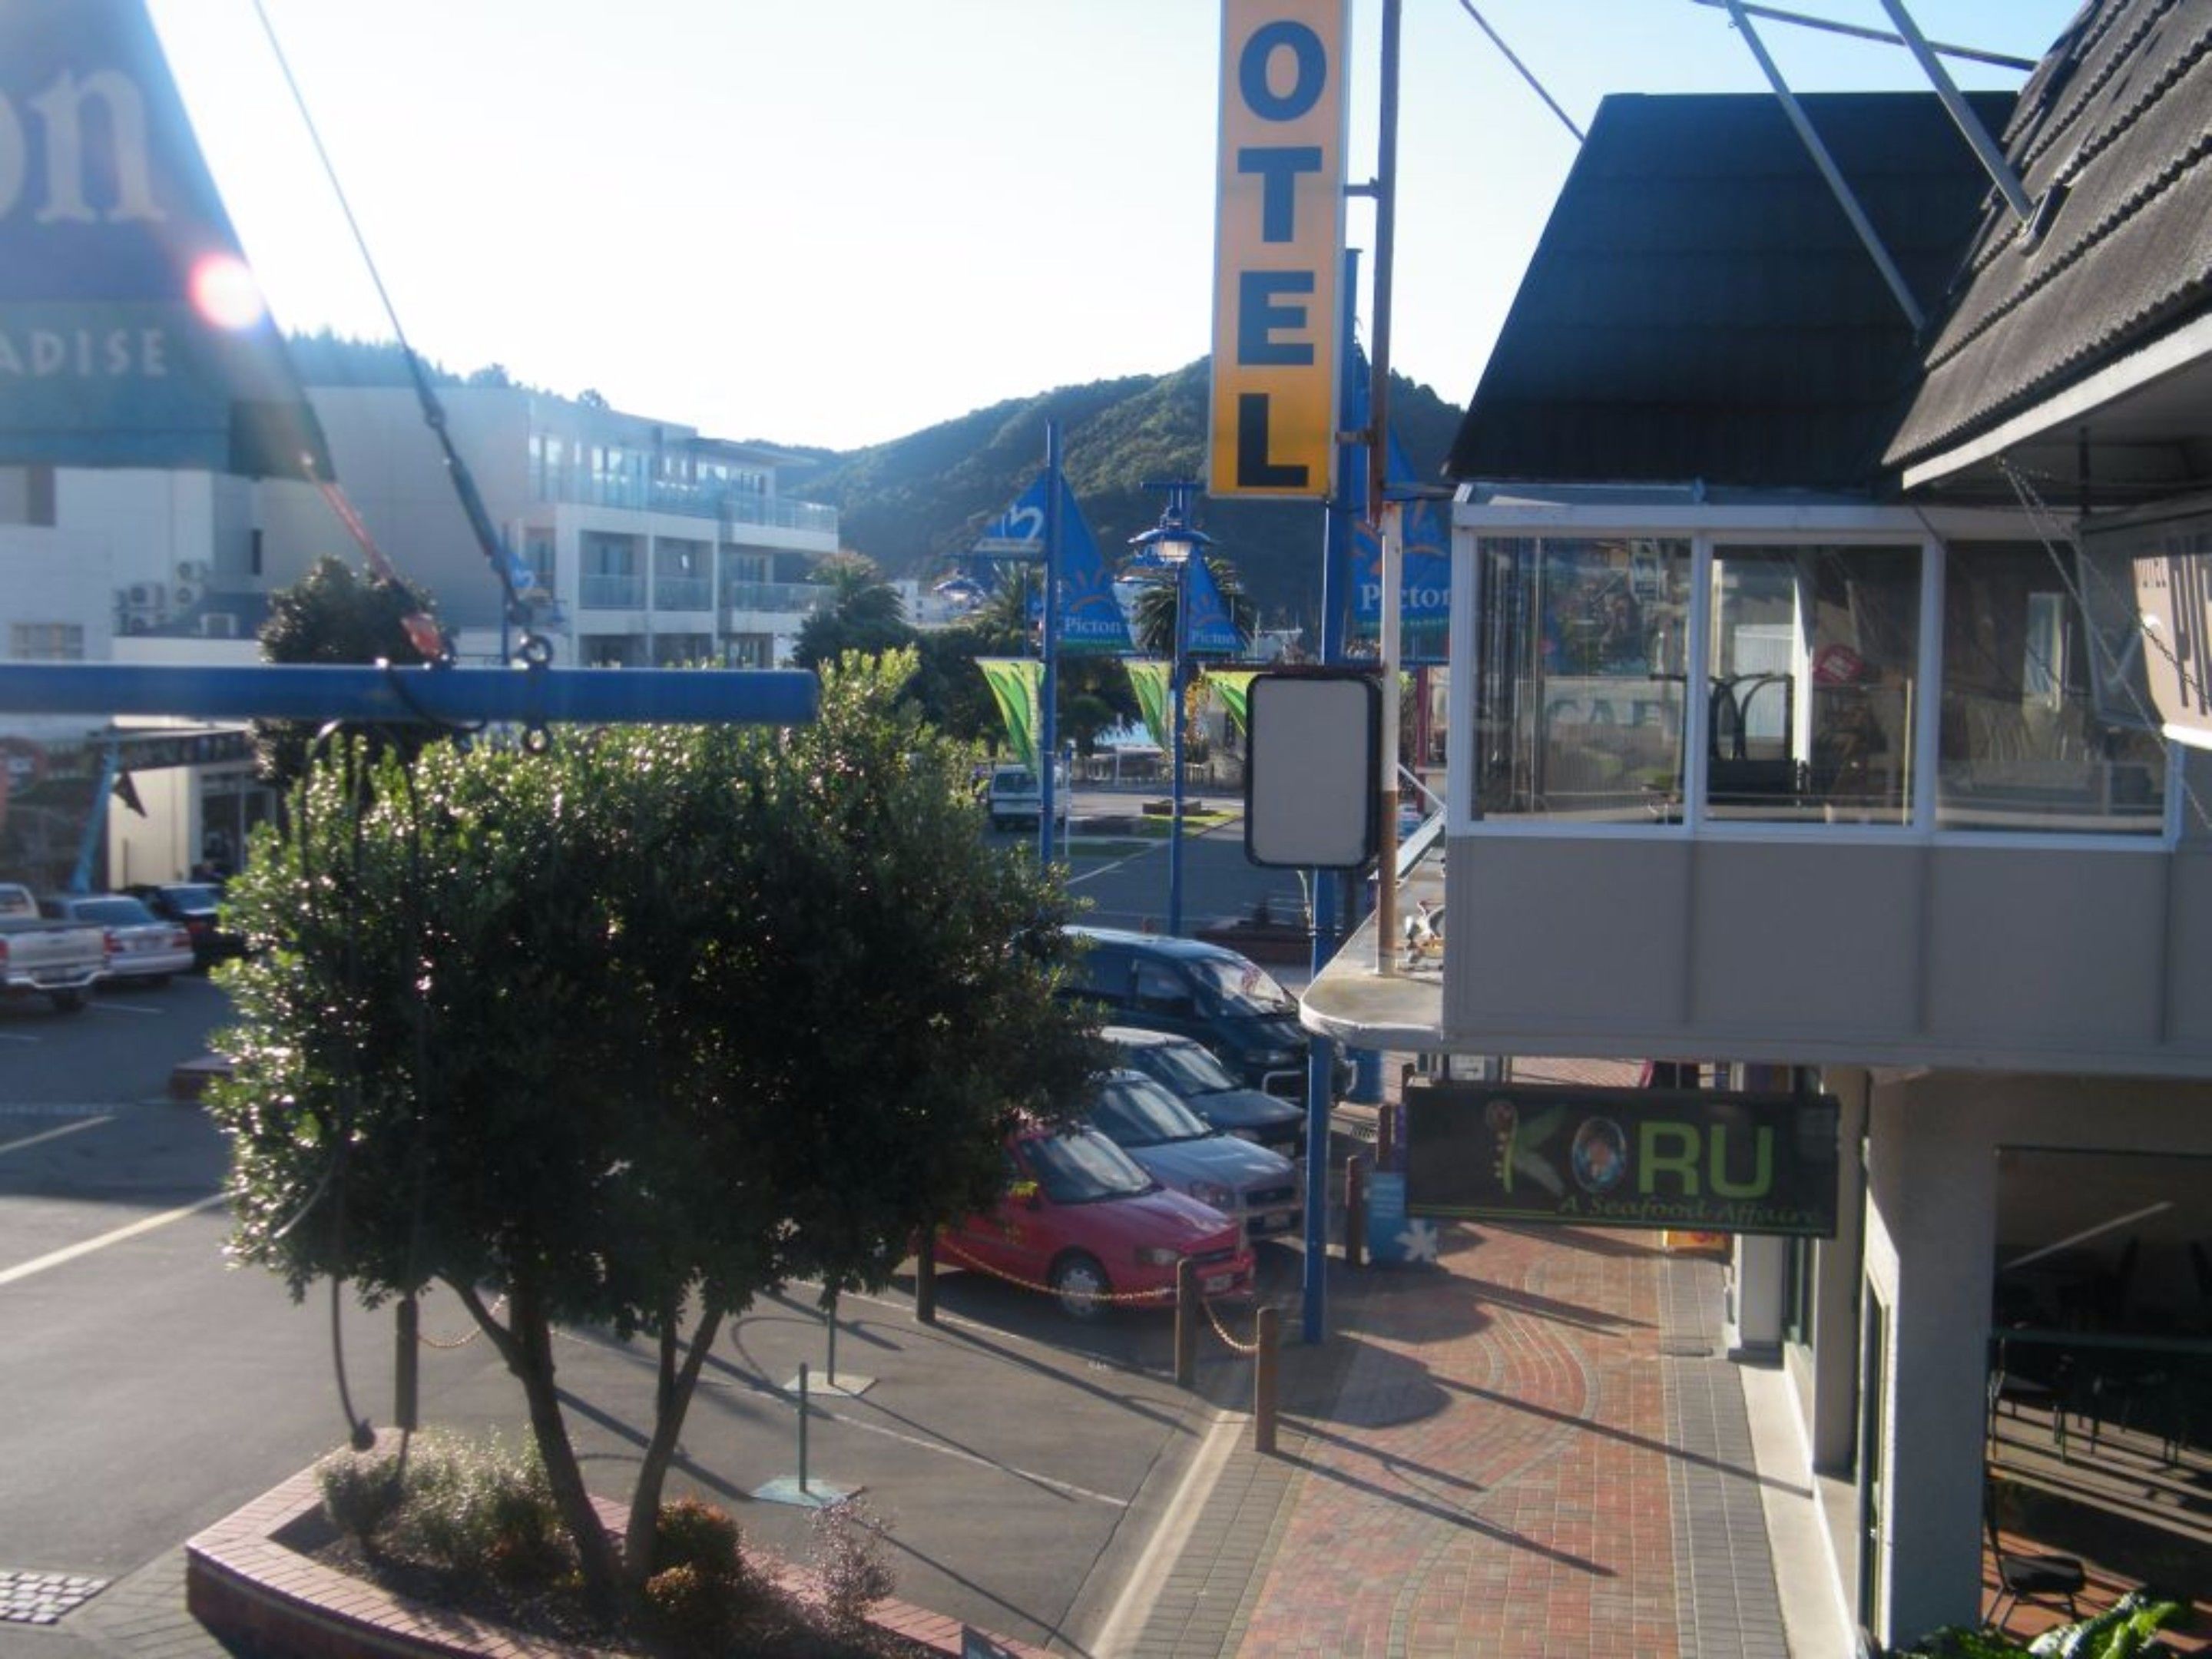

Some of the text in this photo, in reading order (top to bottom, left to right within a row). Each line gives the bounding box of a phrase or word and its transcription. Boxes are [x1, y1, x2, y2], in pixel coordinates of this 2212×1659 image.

[1237, 19, 1327, 488] OTEL
[1065, 615, 1121, 634] Picton
[1485, 1100, 1773, 1198] KORU
